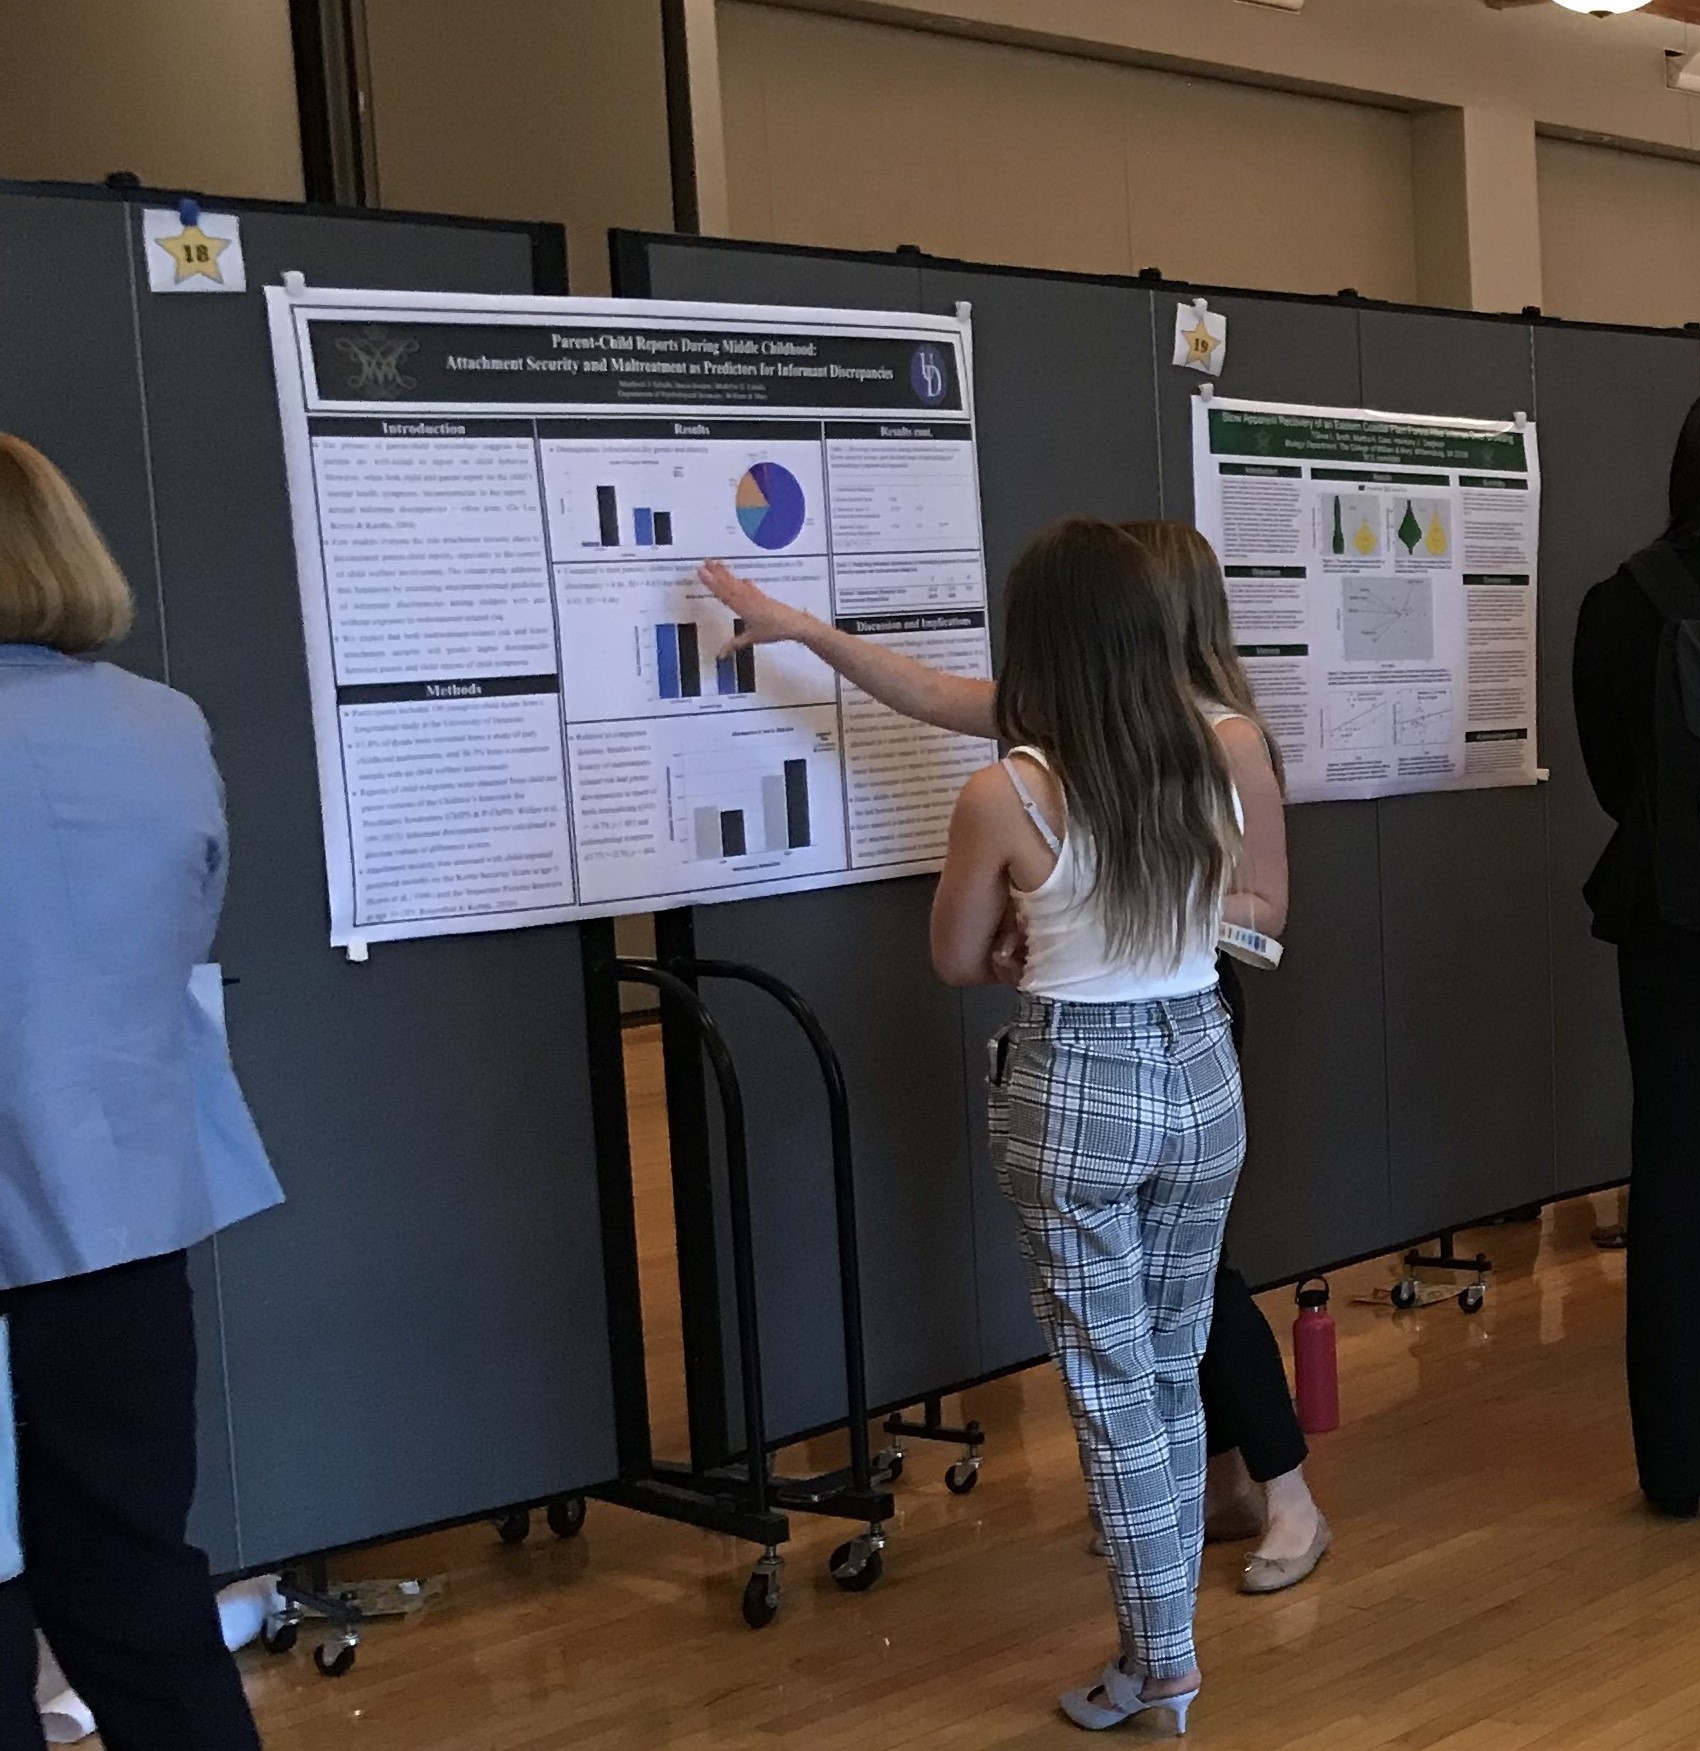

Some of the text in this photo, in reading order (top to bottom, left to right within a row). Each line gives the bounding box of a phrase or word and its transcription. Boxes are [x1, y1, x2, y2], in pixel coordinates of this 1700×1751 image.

[184, 244, 210, 263] 18
[552, 333, 817, 357] Parent-Child Reports During Middle Childhood:
[1194, 338, 1209, 353] 19
[447, 355, 894, 383] Attachment Security and Maltreatment as Predictors for Informant Discrepancies
[382, 422, 466, 435] Introduction
[674, 423, 711, 436] Results
[856, 616, 972, 632] Discussion and Implications
[426, 683, 483, 698] Methods
